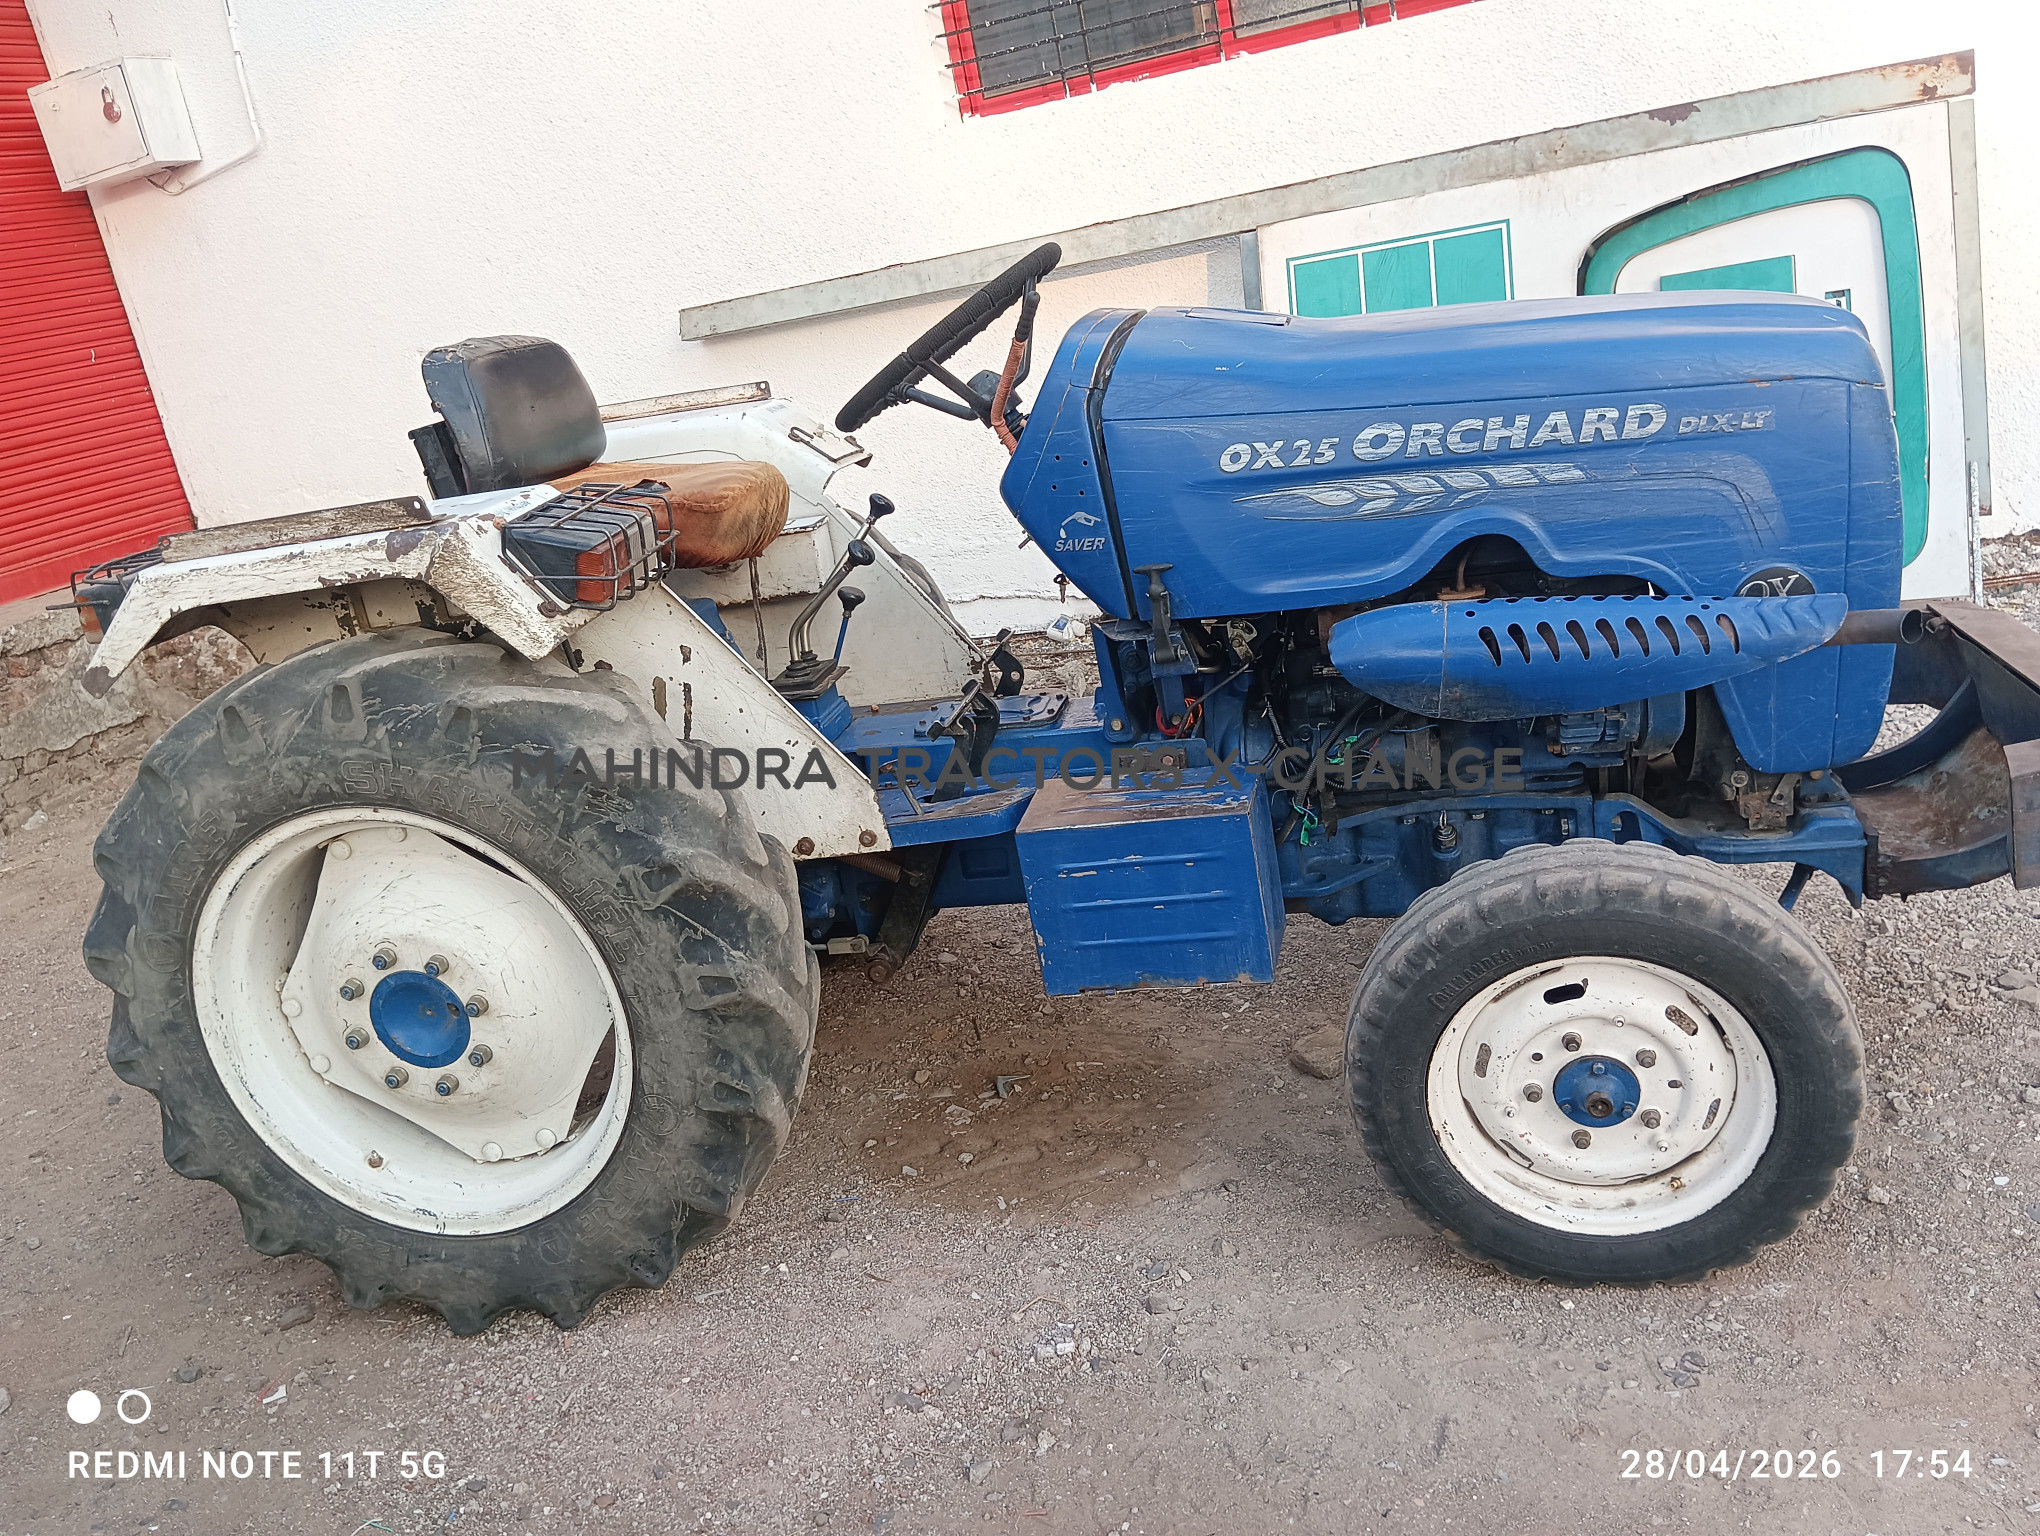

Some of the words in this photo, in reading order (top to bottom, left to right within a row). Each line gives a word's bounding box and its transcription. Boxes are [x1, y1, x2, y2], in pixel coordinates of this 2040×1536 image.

[1351, 403, 1668, 462] ORCHARD
[1054, 537, 1106, 552] SAVER
[340, 760, 556, 853] SHAKTI
[550, 850, 646, 964] LIFE
